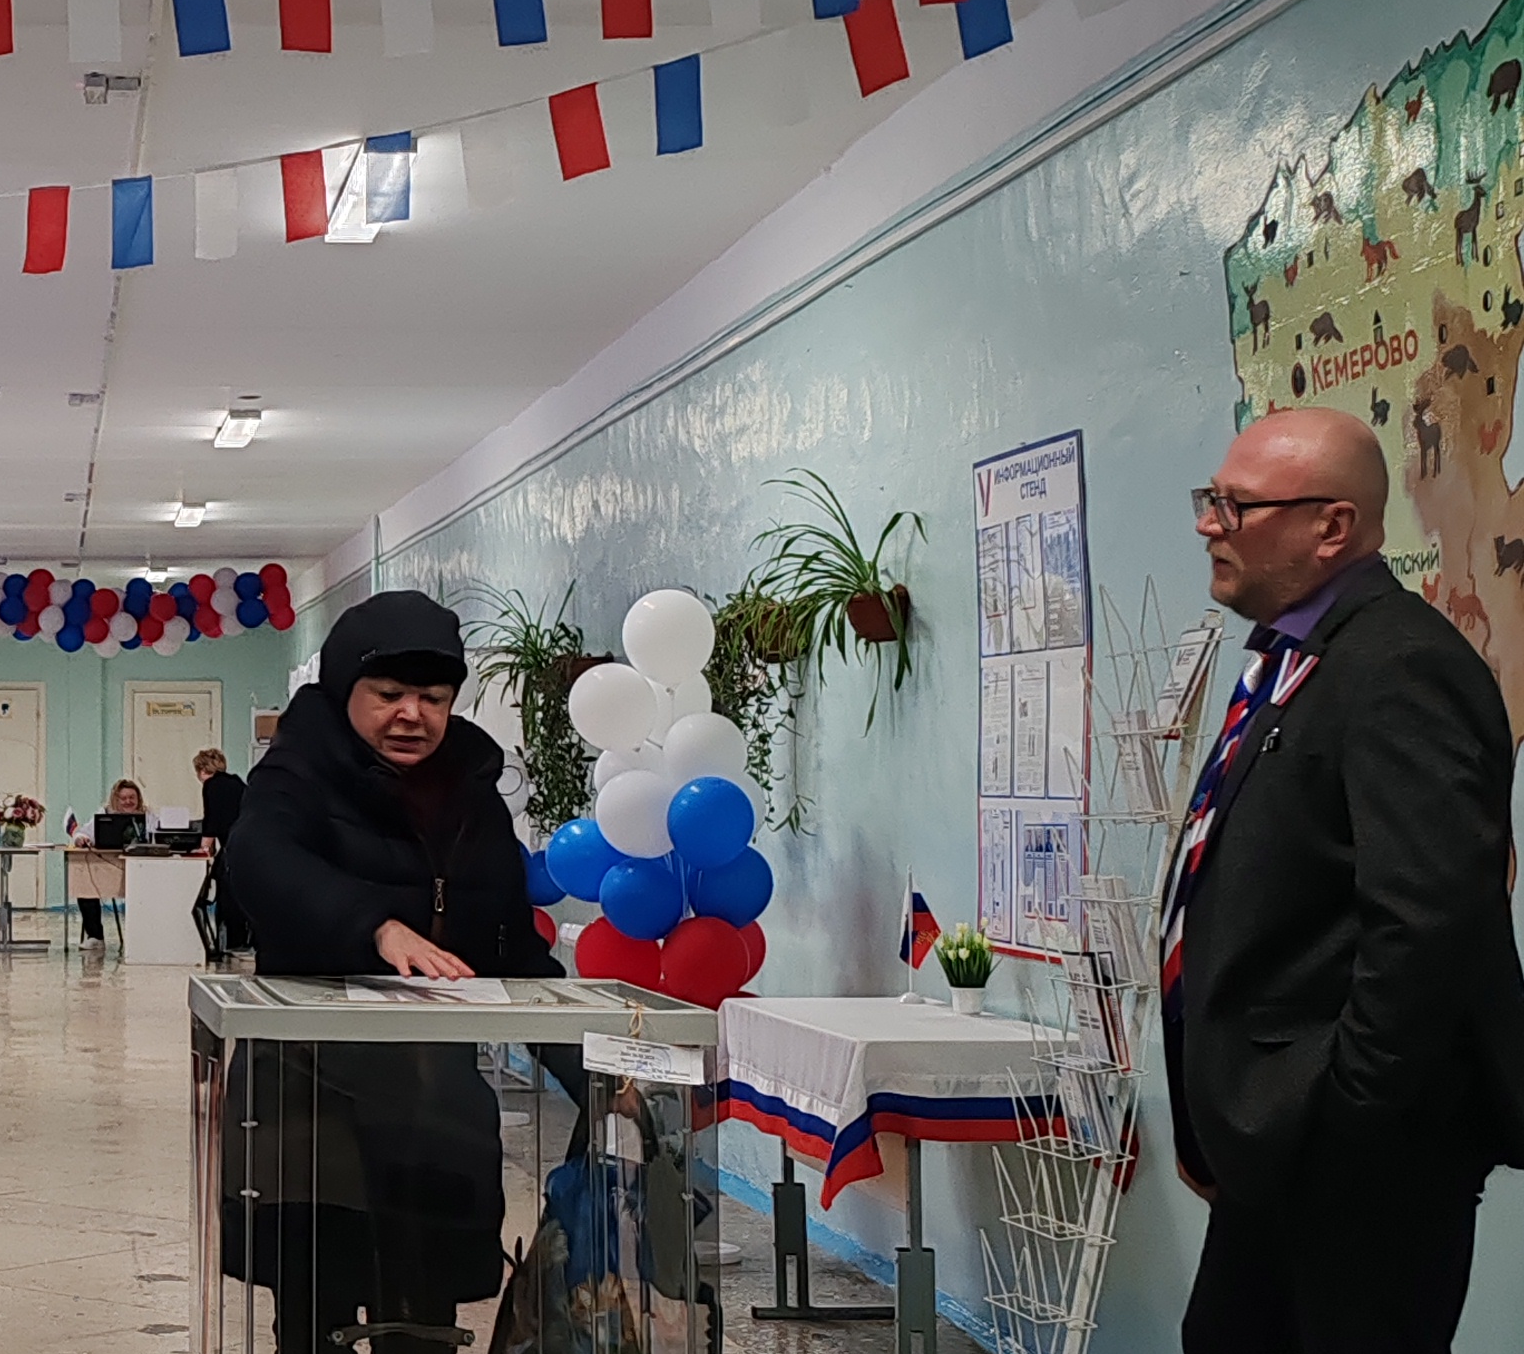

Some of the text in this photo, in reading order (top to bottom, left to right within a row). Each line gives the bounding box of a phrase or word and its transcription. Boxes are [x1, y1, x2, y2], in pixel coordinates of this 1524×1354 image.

[1310, 329, 1419, 396] КЕМЕРОВО
[994, 441, 1076, 485] ИНФОРМАЦИОННЫЙ
[1019, 477, 1047, 500] СТЕНД
